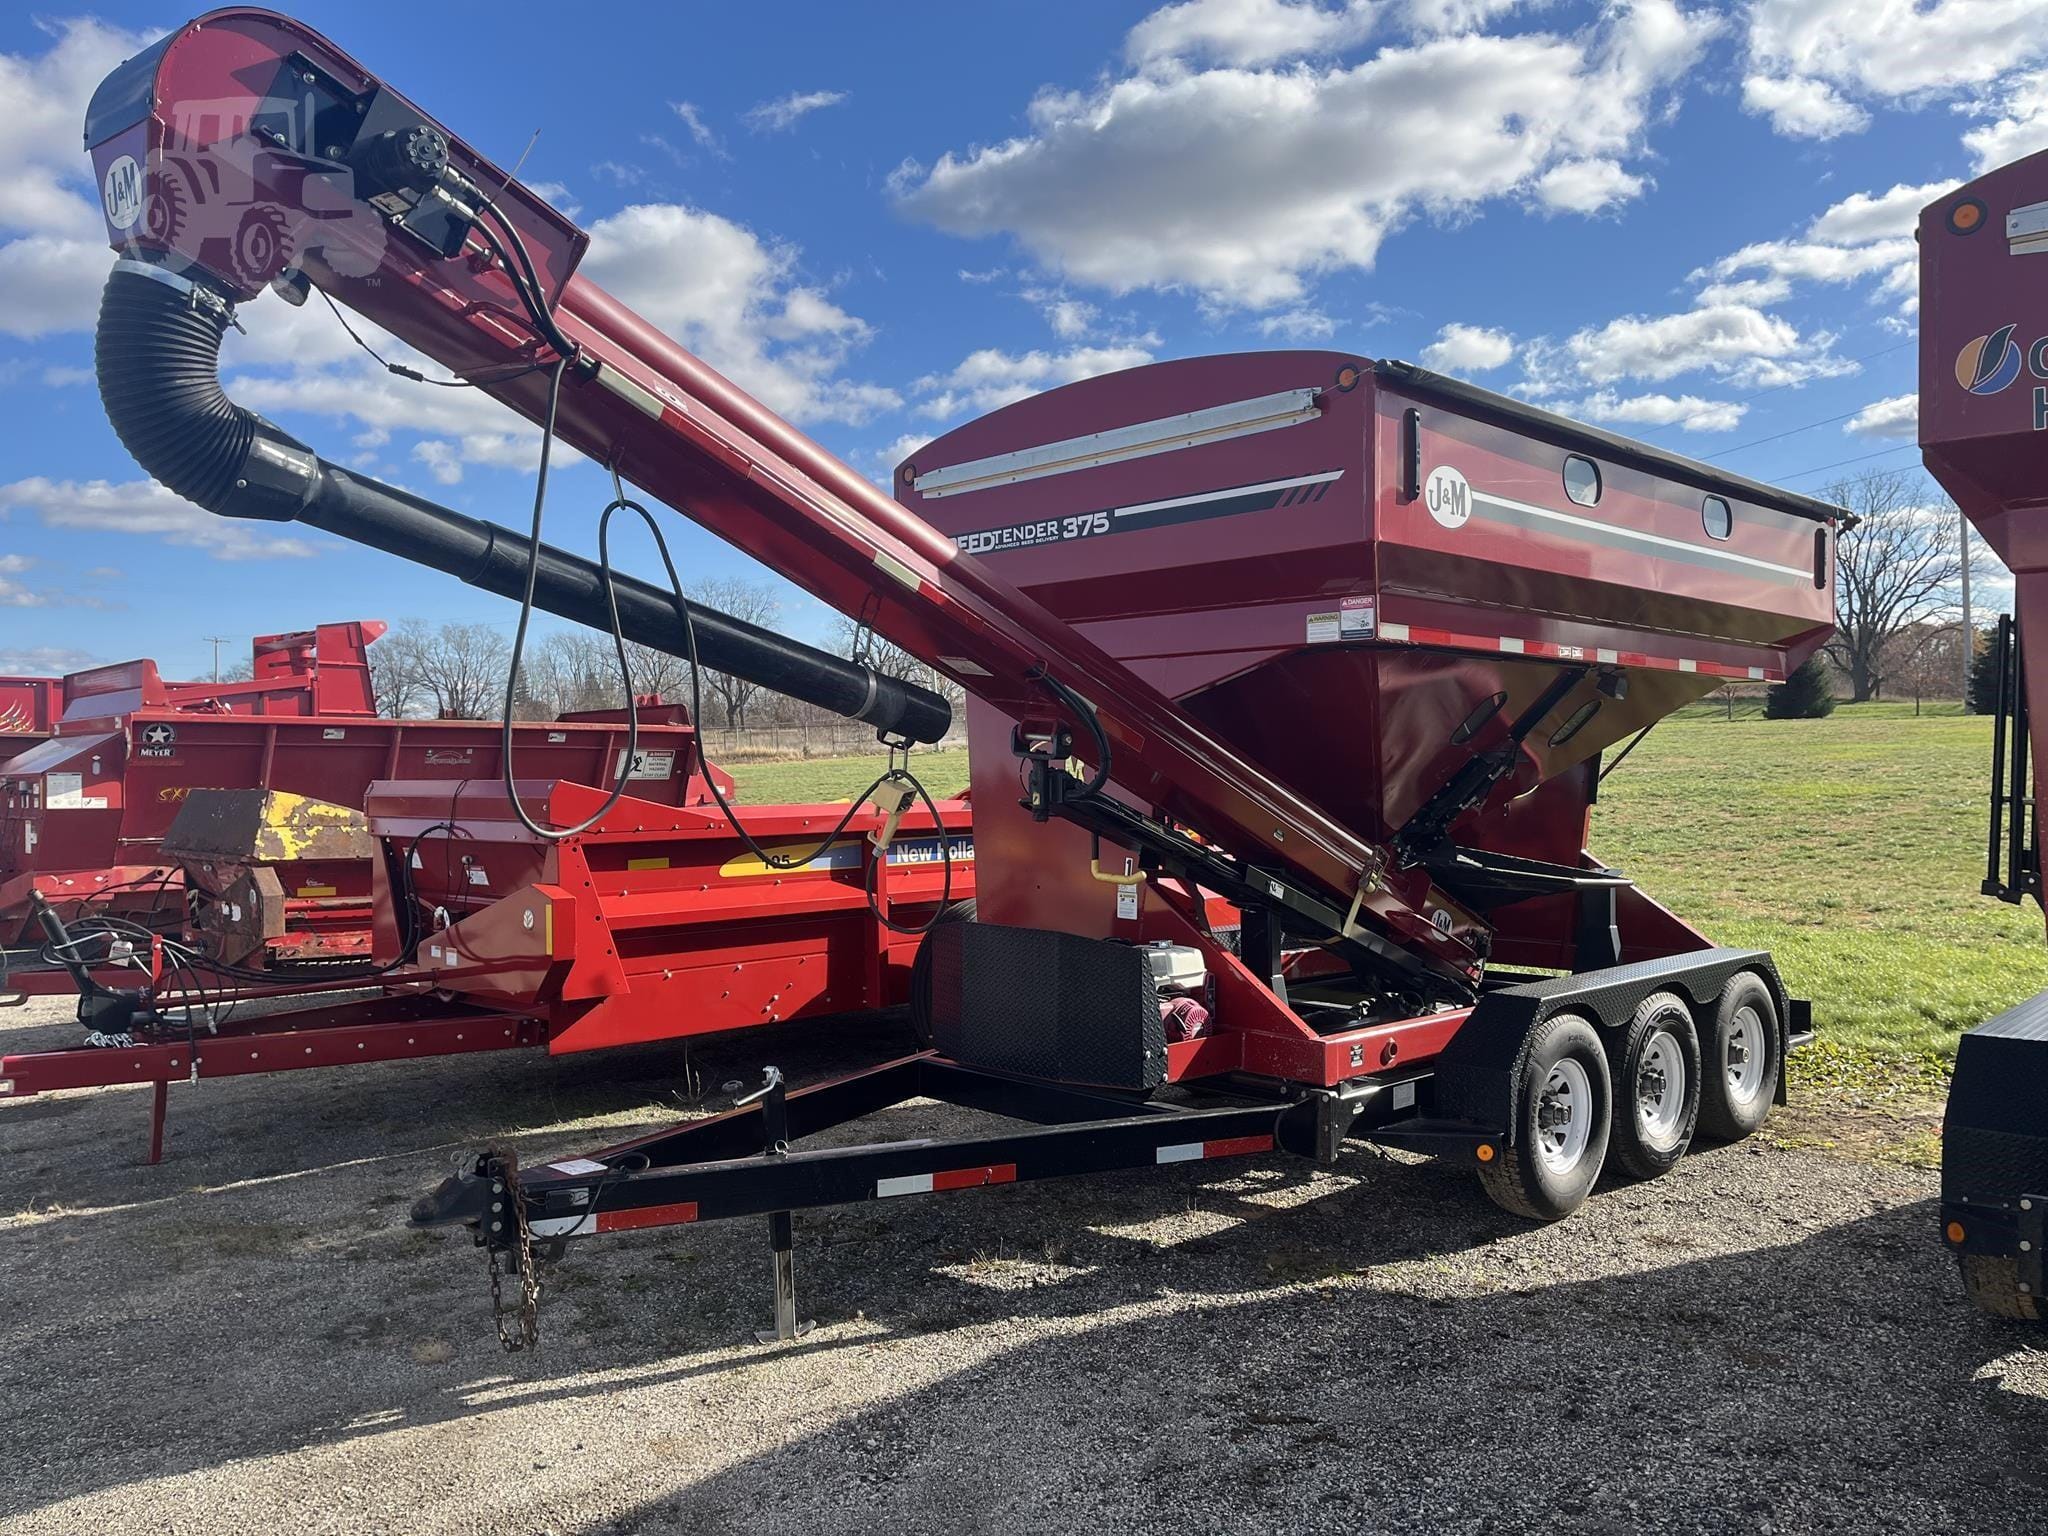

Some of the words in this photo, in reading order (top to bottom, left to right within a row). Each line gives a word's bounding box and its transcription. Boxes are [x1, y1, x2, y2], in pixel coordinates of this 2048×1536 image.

[107, 162, 138, 217] J&M
[1428, 476, 1467, 518] J&M
[950, 520, 1060, 554] EEDTENDER
[1062, 511, 1110, 539] 375
[1347, 597, 1373, 606] DANGER
[140, 748, 171, 757] MEYER
[896, 844, 932, 863] New
